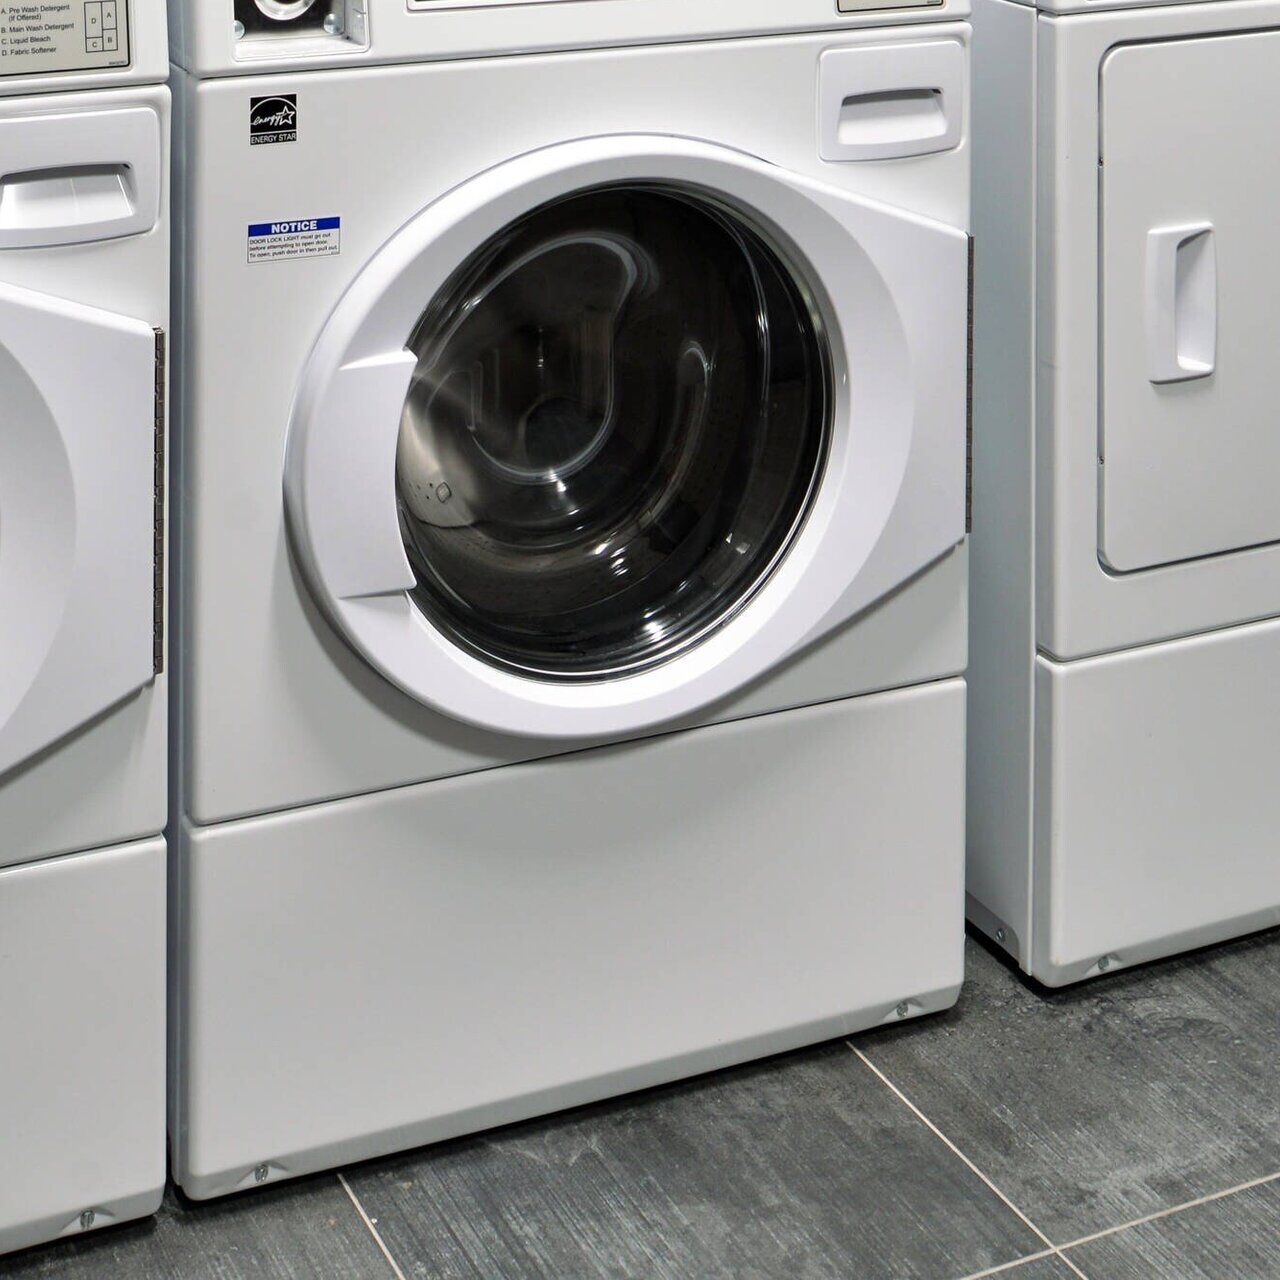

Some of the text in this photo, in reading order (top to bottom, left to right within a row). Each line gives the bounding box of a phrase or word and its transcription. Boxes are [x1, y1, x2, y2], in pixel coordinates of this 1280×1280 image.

[41, 4, 70, 12] Detergent
[17, 13, 42, 21] Offered)
[45, 23, 75, 31] Detergent
[251, 133, 296, 144] ENERGY STAR
[271, 221, 318, 233] NOTICE
